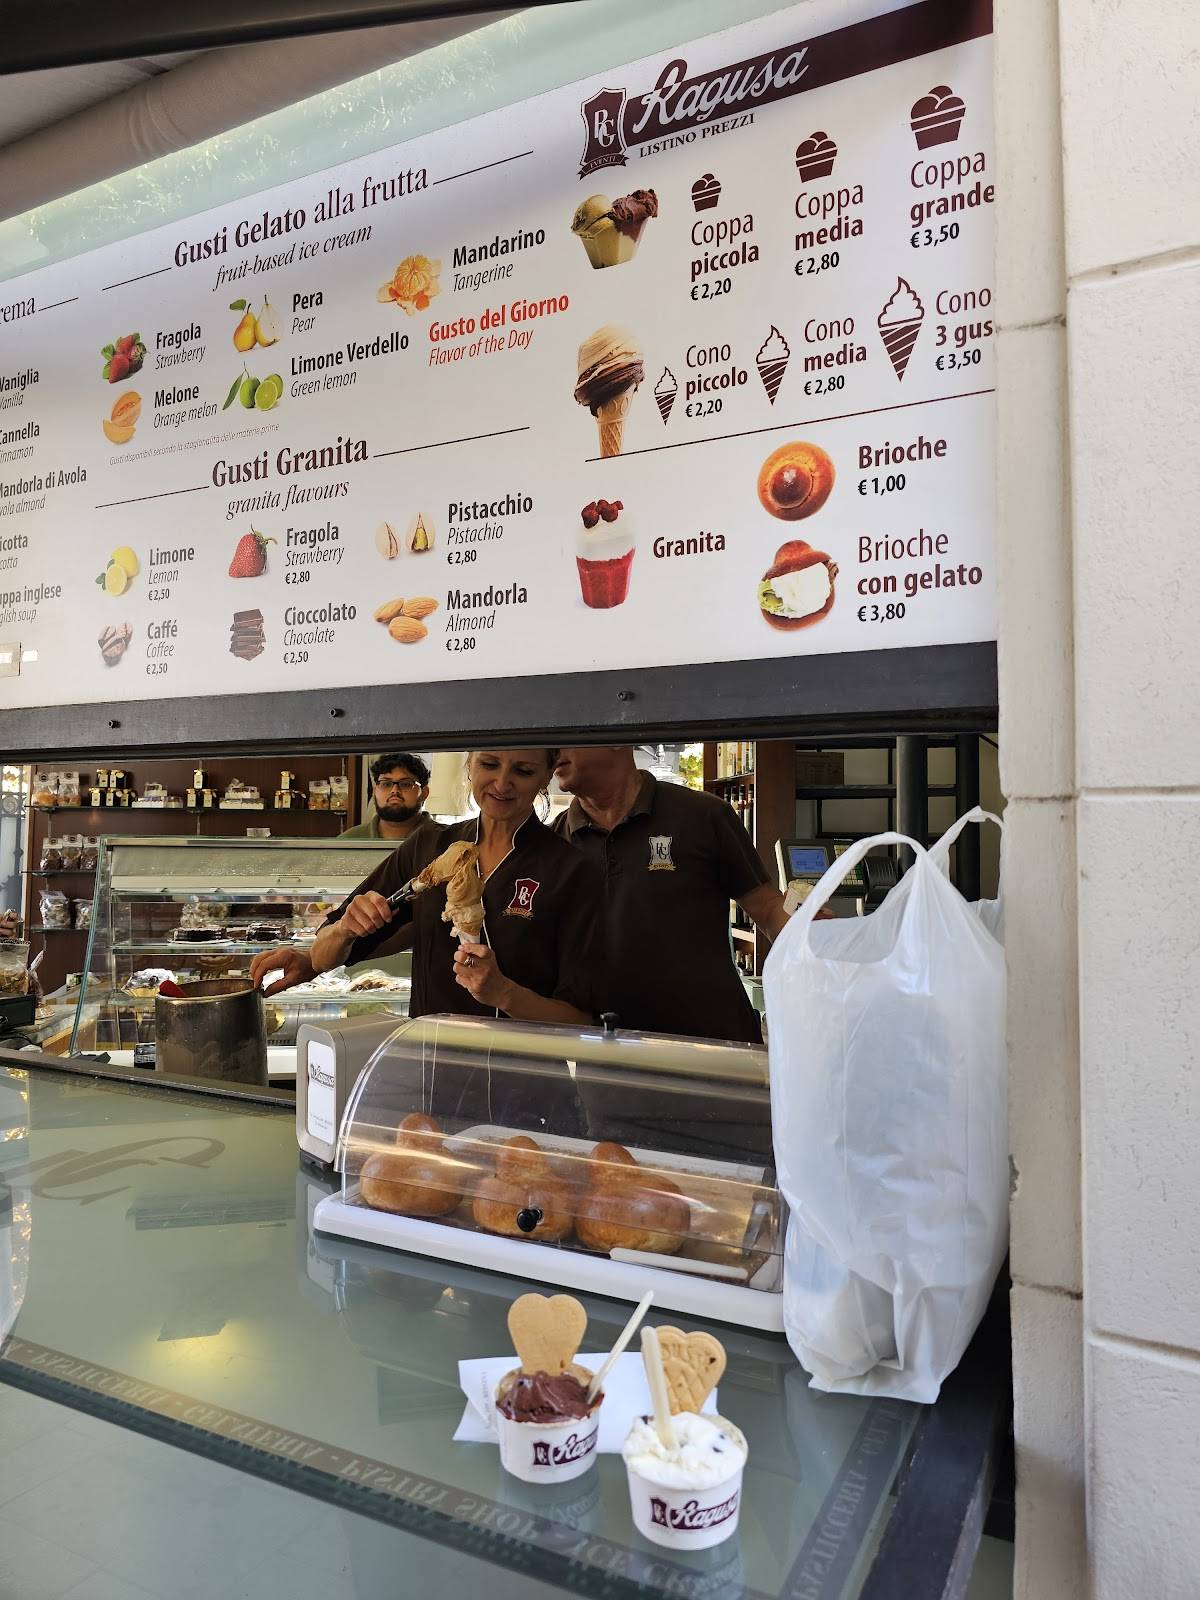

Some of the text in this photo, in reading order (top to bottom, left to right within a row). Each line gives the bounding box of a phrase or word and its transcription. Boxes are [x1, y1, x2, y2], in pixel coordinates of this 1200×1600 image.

[632, 46, 810, 134] Ragusa
[639, 113, 756, 158] LISTINO PREZZI
[910, 151, 987, 190] Coppa
[795, 184, 864, 221] Coppa
[910, 181, 996, 229] grande
[174, 168, 429, 267] Gusti Gelato alla frutta
[691, 213, 755, 247] Coppa
[795, 217, 864, 251] media
[212, 225, 373, 292] fruit-based ice cream
[452, 229, 546, 269] Mandarino
[691, 241, 760, 282] piccola
[453, 263, 514, 292] Tangerine
[292, 291, 323, 312] Pera
[936, 288, 991, 315] Cono
[291, 316, 316, 335] Pear
[429, 294, 569, 342] Gusto del Giorno
[803, 316, 855, 344] Cono
[156, 322, 202, 350] Fragola
[428, 329, 534, 367] Flavor of the Day
[936, 325, 947, 346] 3
[155, 345, 207, 370] Strawberry
[291, 331, 409, 376] Limone Verdello
[686, 343, 732, 369] Cono
[803, 342, 868, 373] media
[154, 385, 200, 409] Melone
[290, 371, 357, 398] Green lemon
[686, 365, 748, 400] piccolo
[153, 402, 218, 429] Orange melon
[212, 436, 369, 487] Gusti Granita
[858, 435, 948, 470] Brioche
[45, 472, 55, 489] di
[57, 466, 87, 487] Avola
[225, 481, 350, 521] granita flavours
[448, 492, 533, 524] Pistacchio
[286, 521, 339, 548] Fragola
[447, 522, 504, 545] Pistachio
[653, 530, 727, 559] Granita
[858, 528, 950, 564] Brioche
[149, 547, 195, 566] Limone
[285, 546, 345, 567] Strawberry
[148, 568, 179, 585] Lemon
[857, 563, 984, 597] con gelato
[23, 583, 62, 605] inglese
[446, 582, 528, 611] Mandorla
[284, 602, 357, 626] Cioccolato
[446, 610, 496, 633] Almond
[146, 643, 175, 659] Coffee
[283, 626, 335, 647] Chocolate
